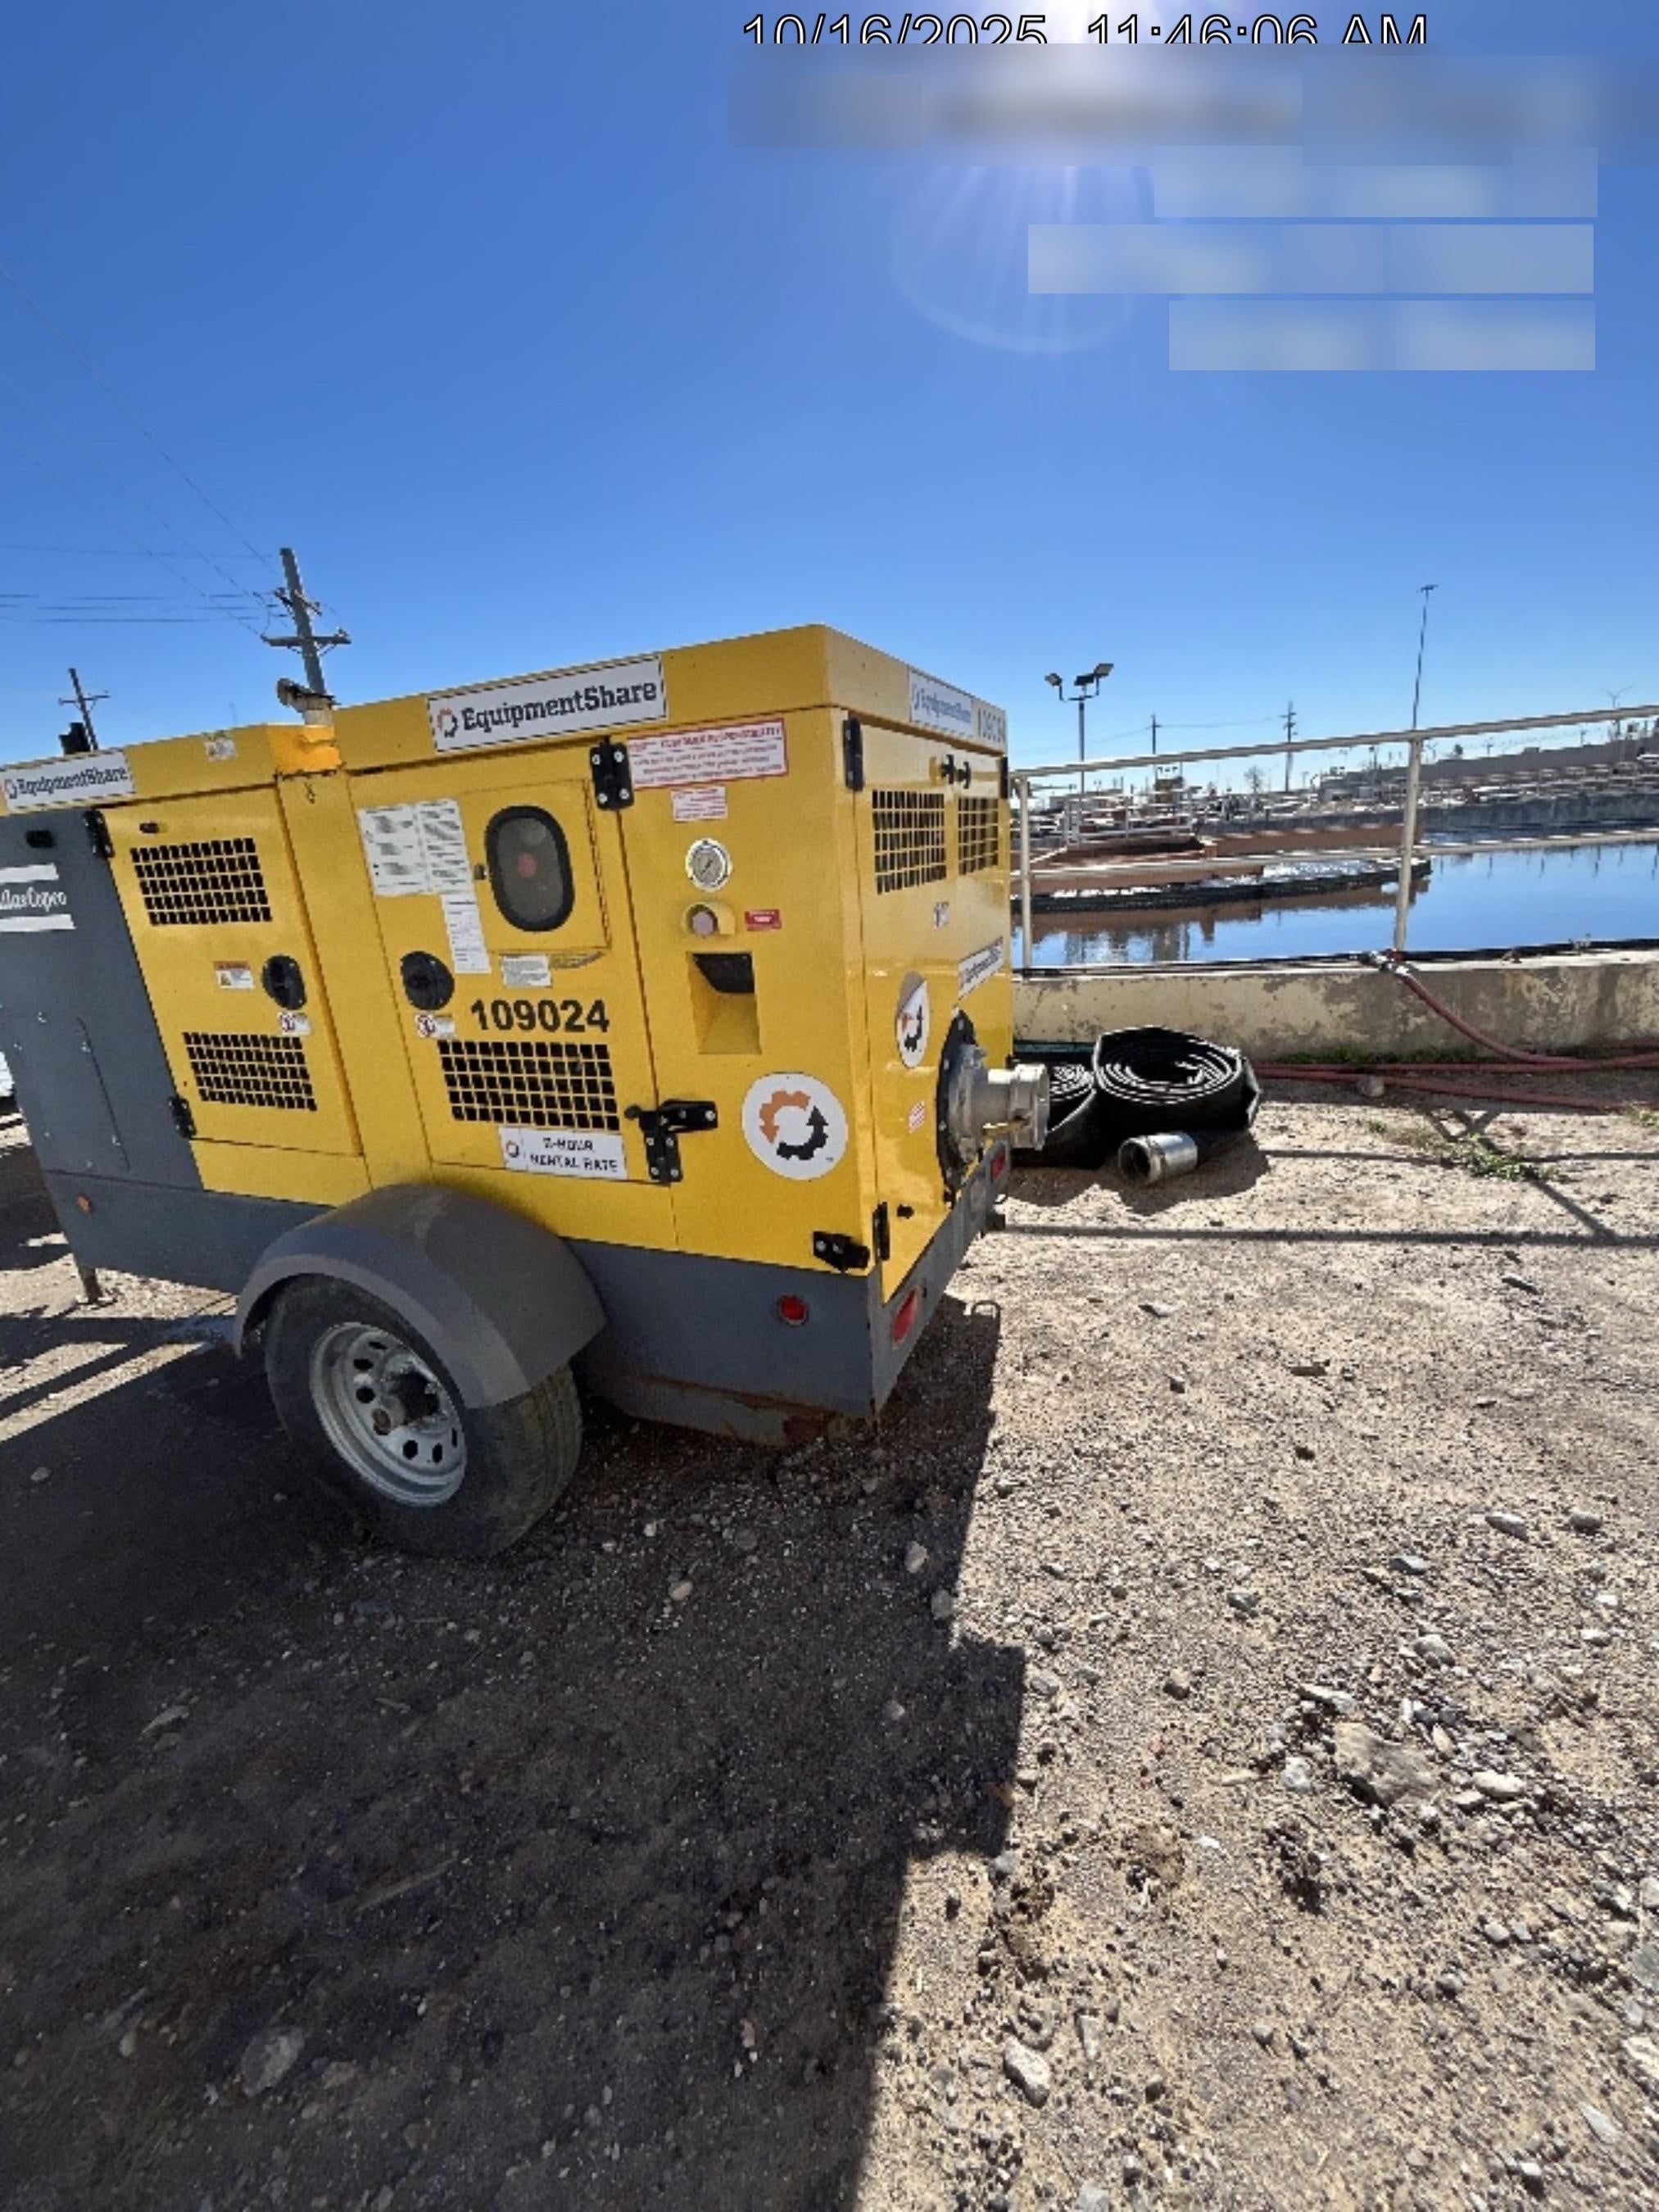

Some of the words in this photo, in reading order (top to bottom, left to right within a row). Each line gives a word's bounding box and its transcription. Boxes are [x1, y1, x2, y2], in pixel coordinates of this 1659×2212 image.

[461, 682, 657, 733] EquipmentShare
[17, 766, 128, 796] EquipmentShare
[470, 999, 610, 1033] 109024
